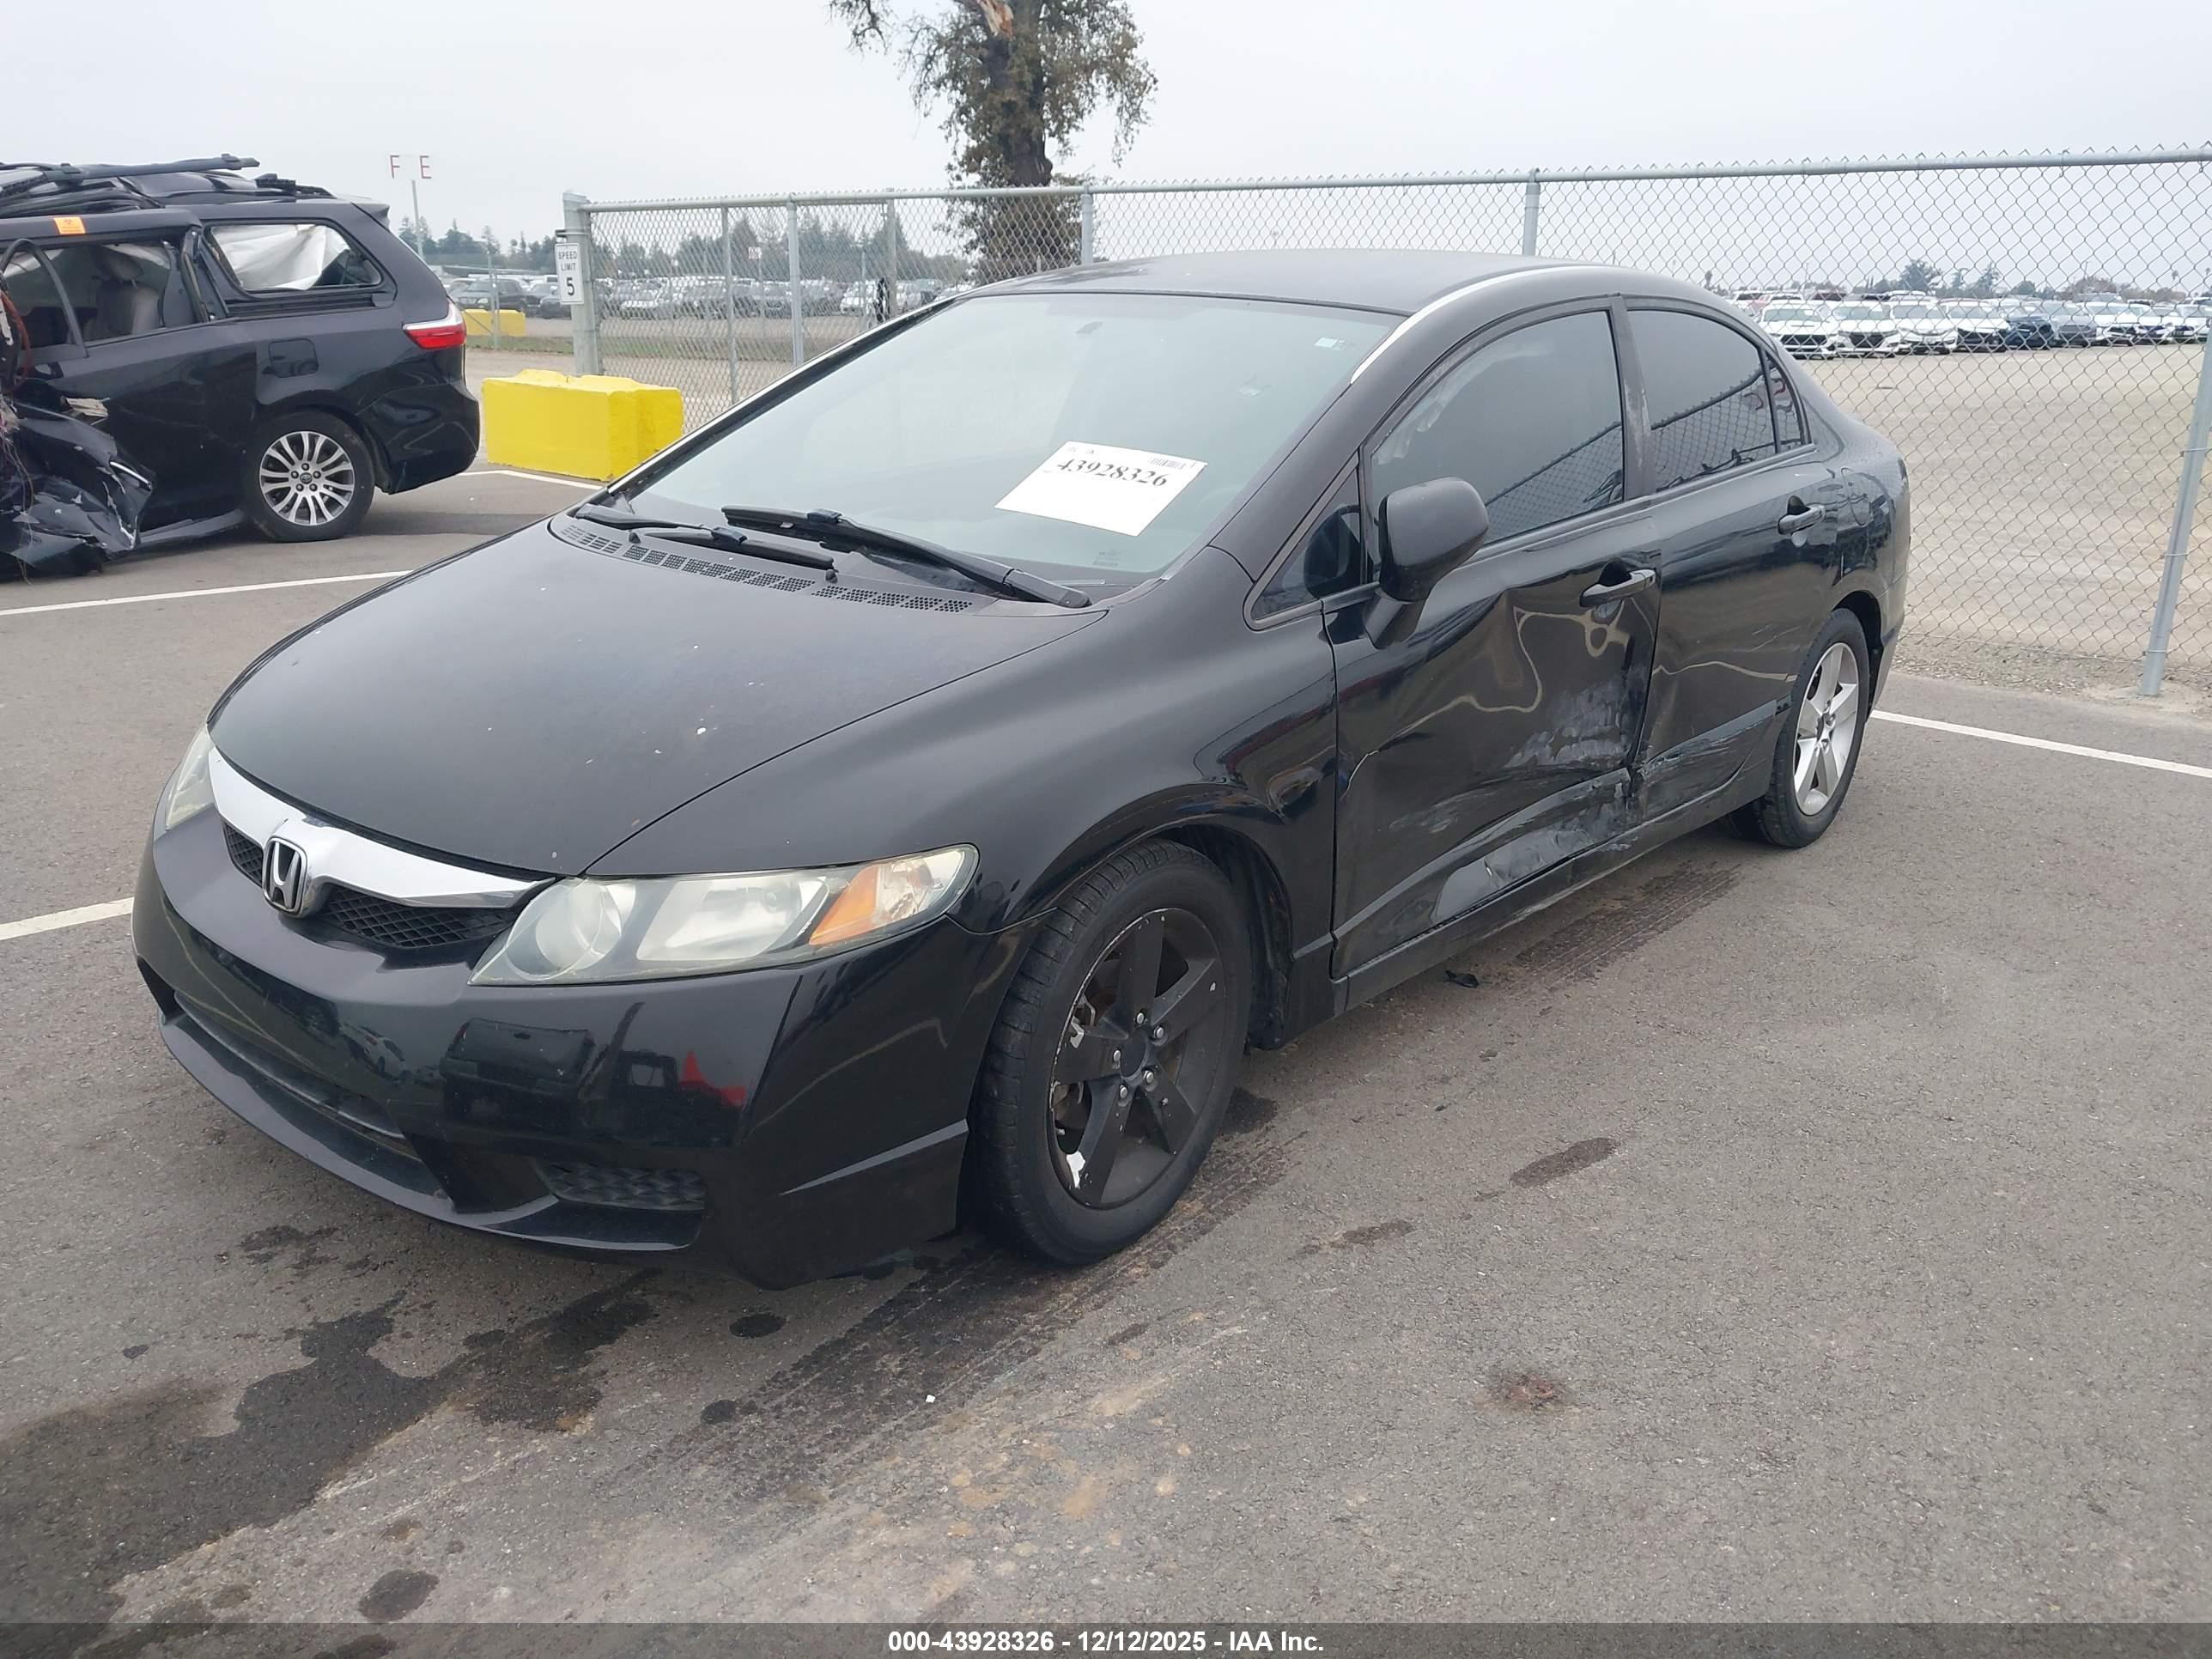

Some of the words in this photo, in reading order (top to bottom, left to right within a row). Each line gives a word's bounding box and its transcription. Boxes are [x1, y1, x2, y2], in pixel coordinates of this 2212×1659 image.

[390, 155, 400, 179] F
[419, 155, 432, 179] E
[558, 251, 577, 259] SPEED
[561, 262, 576, 271] LIMIT
[566, 276, 575, 296] 5
[1057, 459, 1169, 487] 43928326
